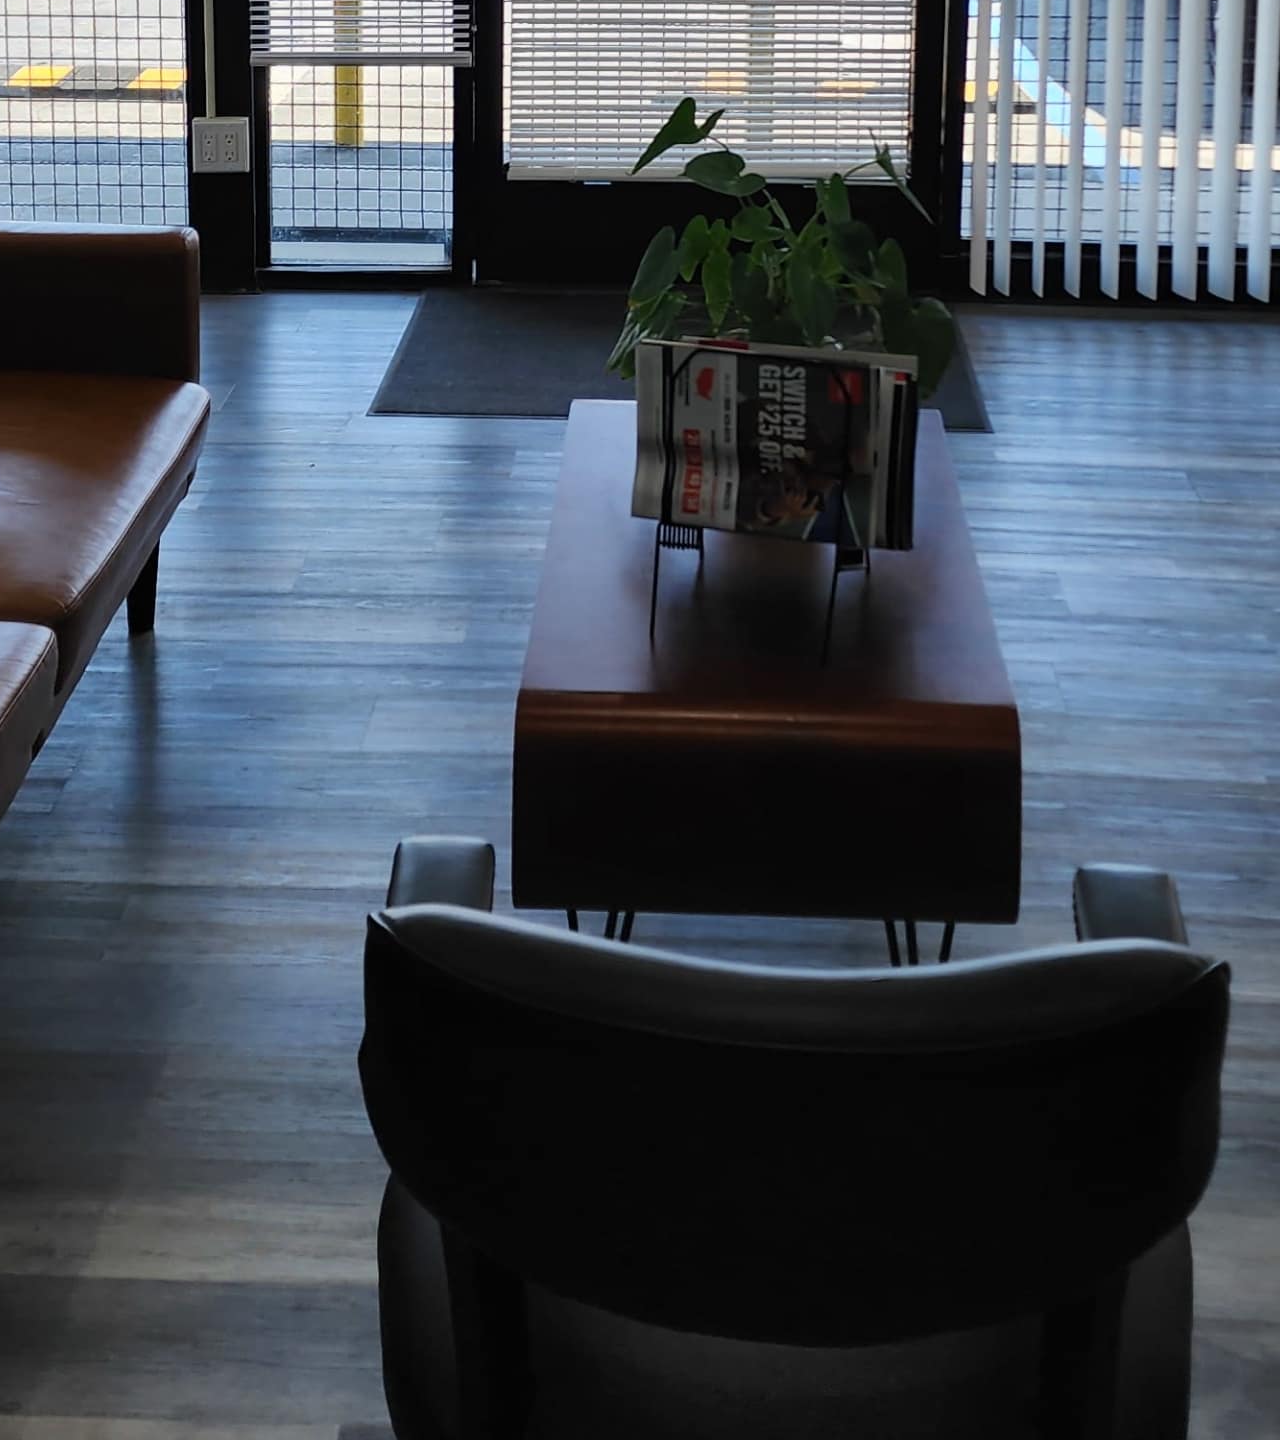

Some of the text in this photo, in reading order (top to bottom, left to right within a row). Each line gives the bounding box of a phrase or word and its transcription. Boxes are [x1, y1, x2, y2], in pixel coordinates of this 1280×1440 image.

[758, 364, 782, 474] GET $25 OFF.
[782, 365, 806, 459] SWITCH &
